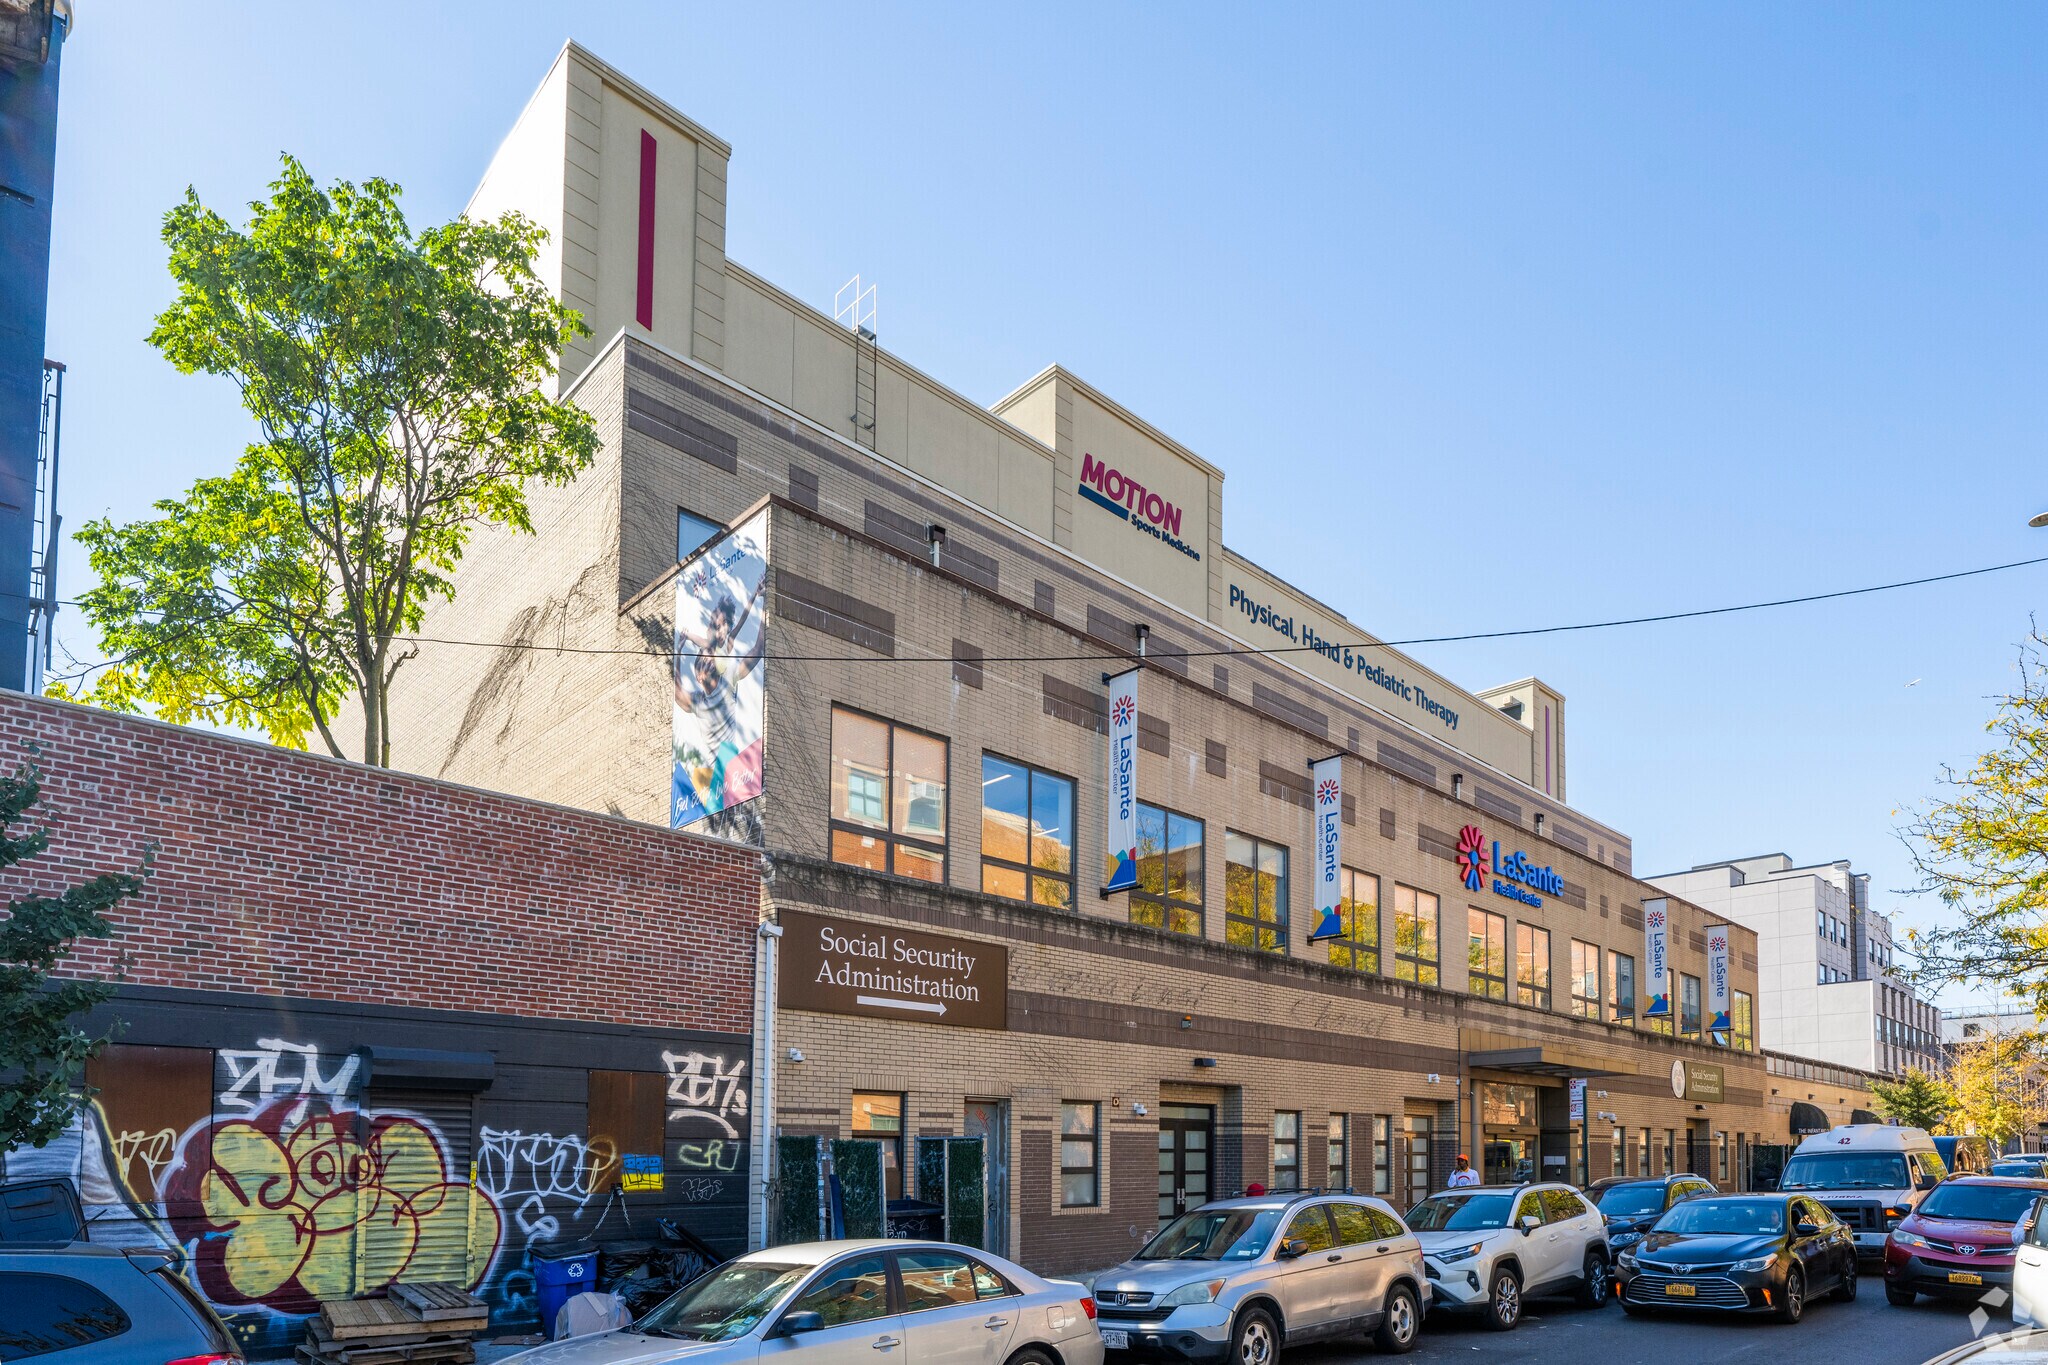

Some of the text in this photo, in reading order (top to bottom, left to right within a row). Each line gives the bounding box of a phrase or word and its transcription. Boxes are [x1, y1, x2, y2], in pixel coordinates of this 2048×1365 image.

[1080, 453, 1182, 536] MOTION
[1131, 514, 1200, 561] Sports Medicine
[1230, 584, 1459, 730] Physical, Hand & Pediatric Therapy
[1120, 734, 1132, 820] LaSante
[1325, 811, 1338, 882] LaSante
[1493, 841, 1564, 897] LaSante
[1493, 879, 1542, 908] Health Center
[820, 927, 976, 979] Social Security
[1654, 933, 1664, 979] LaSante
[815, 960, 980, 1002] Administration
[1716, 956, 1725, 998] LaSante
[1691, 1068, 1719, 1085] Social Security
[1691, 1081, 1720, 1094] Administration
